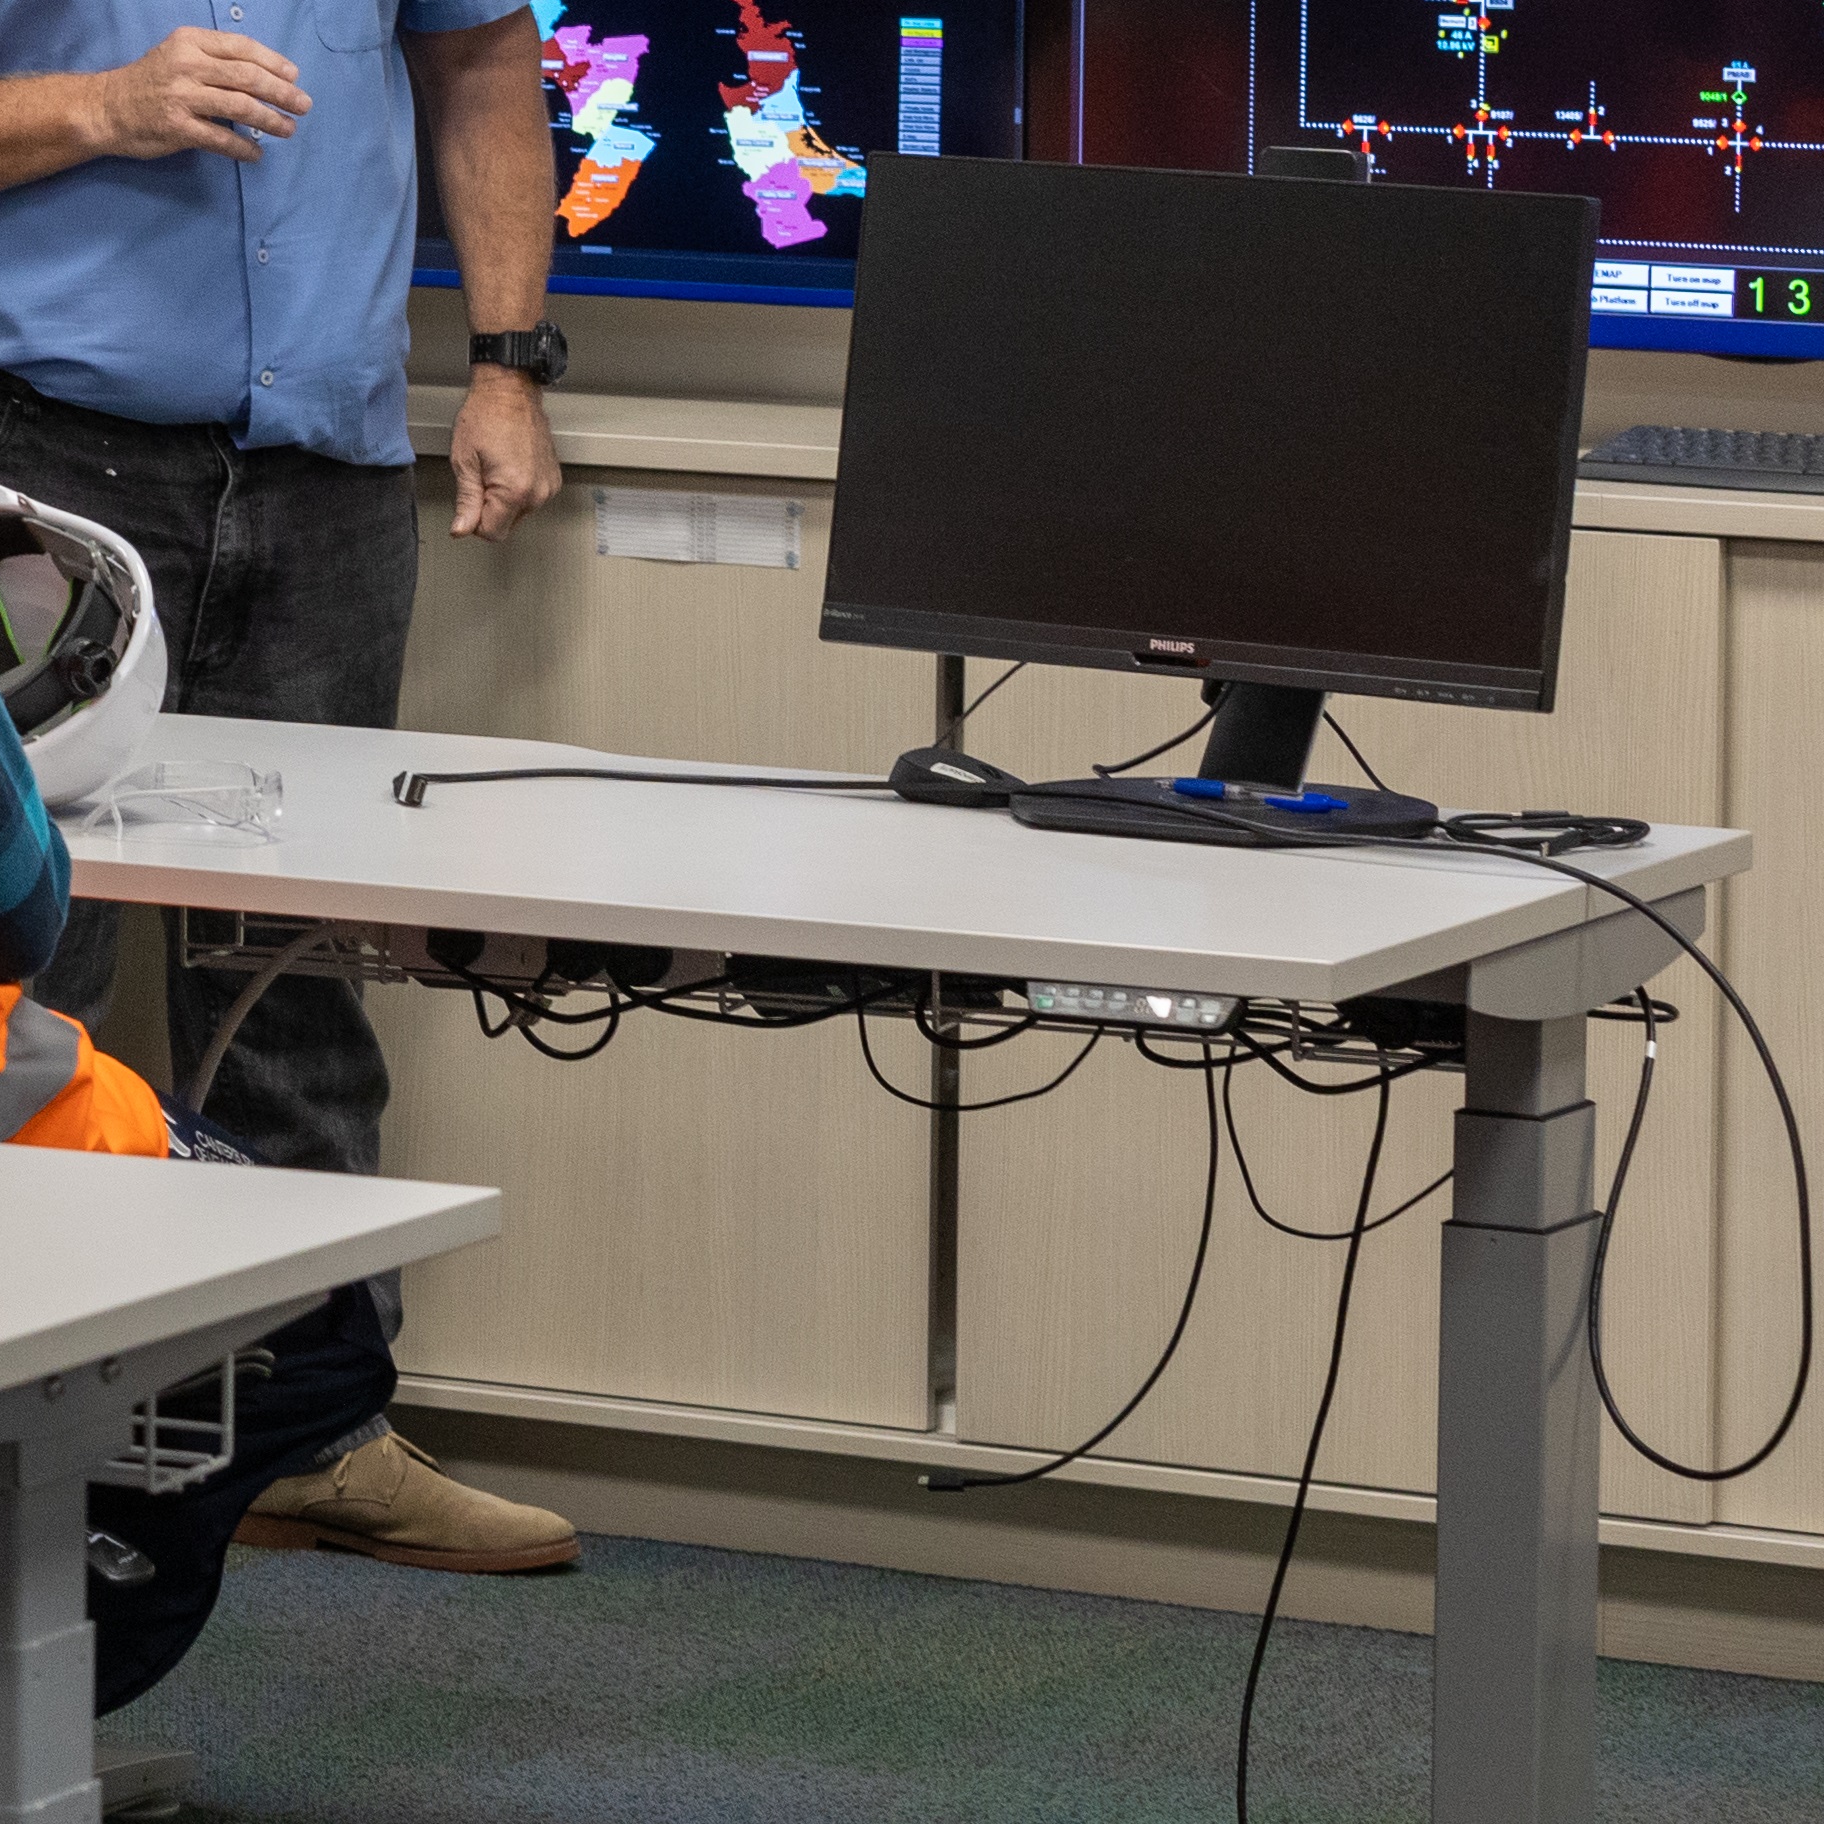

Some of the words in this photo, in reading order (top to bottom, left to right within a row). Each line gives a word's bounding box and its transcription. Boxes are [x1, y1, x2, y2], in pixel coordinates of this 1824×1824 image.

[1667, 273, 1687, 283] Turn
[1702, 277, 1721, 286] map
[1665, 297, 1685, 307] Turn
[1687, 298, 1699, 308] off
[1700, 301, 1720, 310] map
[1149, 639, 1196, 654] PHILIPS
